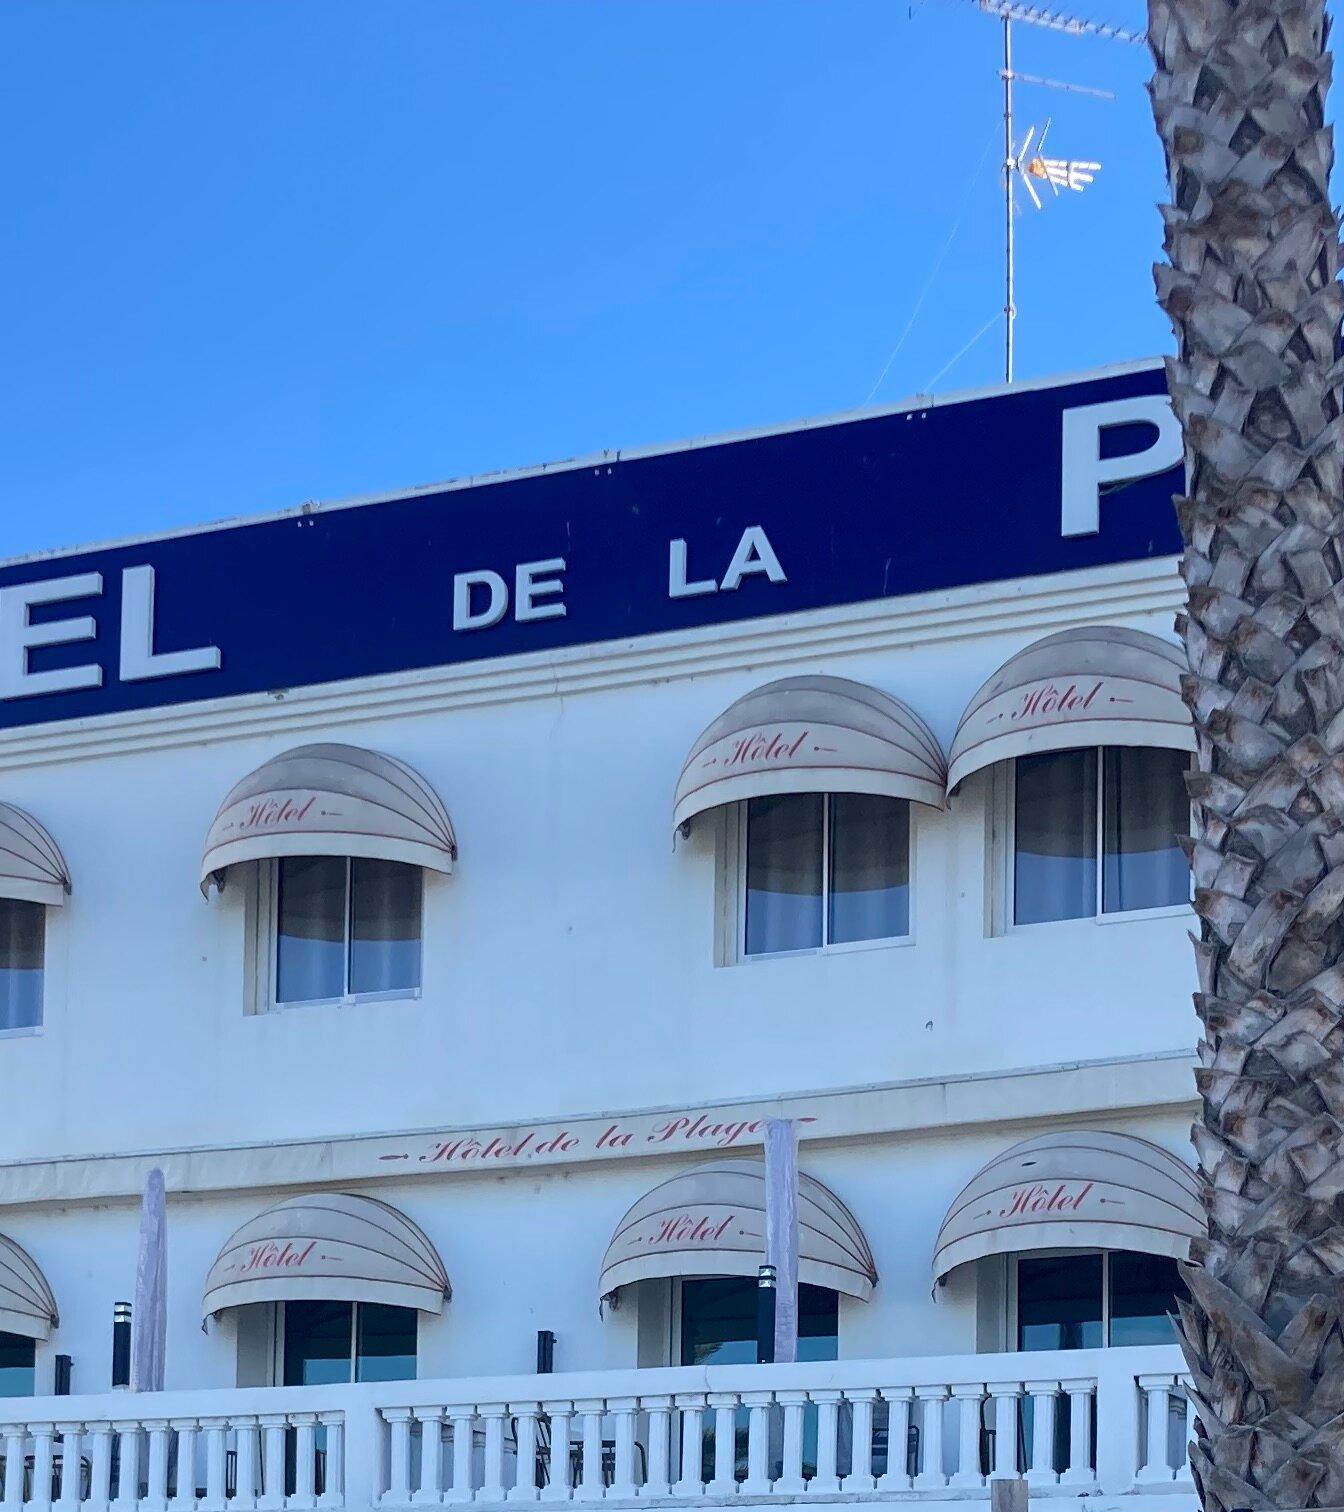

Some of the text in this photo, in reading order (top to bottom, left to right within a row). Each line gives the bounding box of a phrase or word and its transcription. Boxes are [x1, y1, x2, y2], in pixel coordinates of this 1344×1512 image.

[453, 557, 567, 631] DE
[668, 525, 788, 599] LA
[1011, 681, 1104, 720] Hôtel
[724, 731, 808, 767] Hôtel
[239, 797, 317, 829] Hôtel
[419, 1114, 764, 1163] Hôtel de la Plage
[999, 1183, 1094, 1218] Hôtel
[649, 1216, 735, 1244] Hôtel
[239, 1241, 317, 1272] Hôtel
